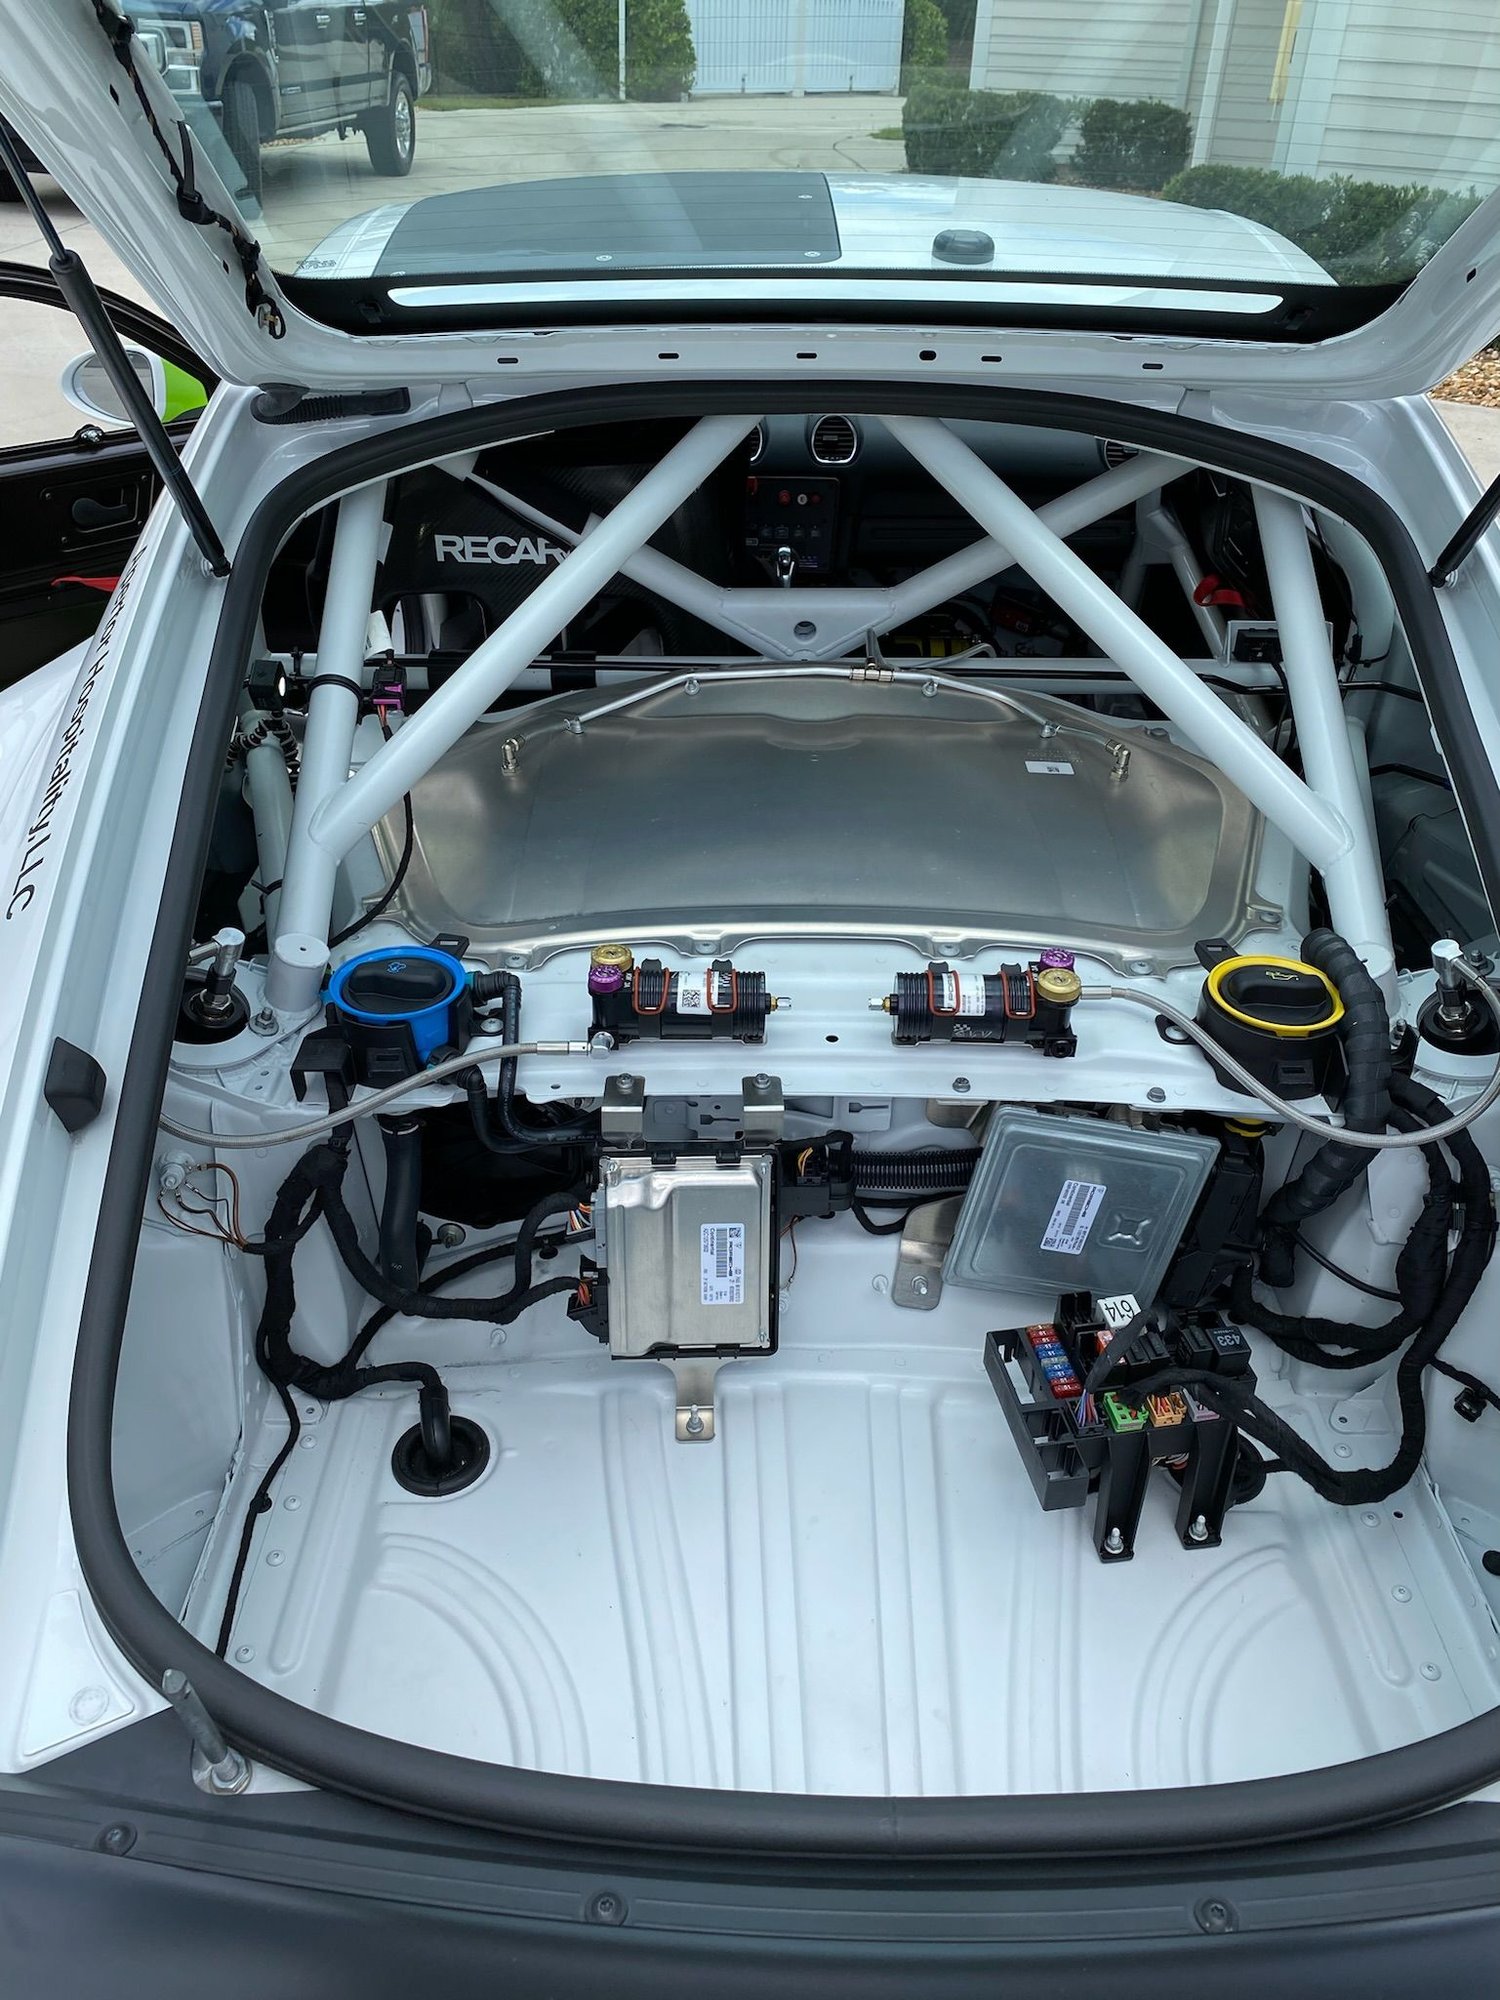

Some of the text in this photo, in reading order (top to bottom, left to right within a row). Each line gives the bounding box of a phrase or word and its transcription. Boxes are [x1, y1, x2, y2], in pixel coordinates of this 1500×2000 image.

[434, 534, 567, 565] RECAR
[1105, 1299, 1135, 1322] 614
[1216, 1332, 1242, 1347] 433
